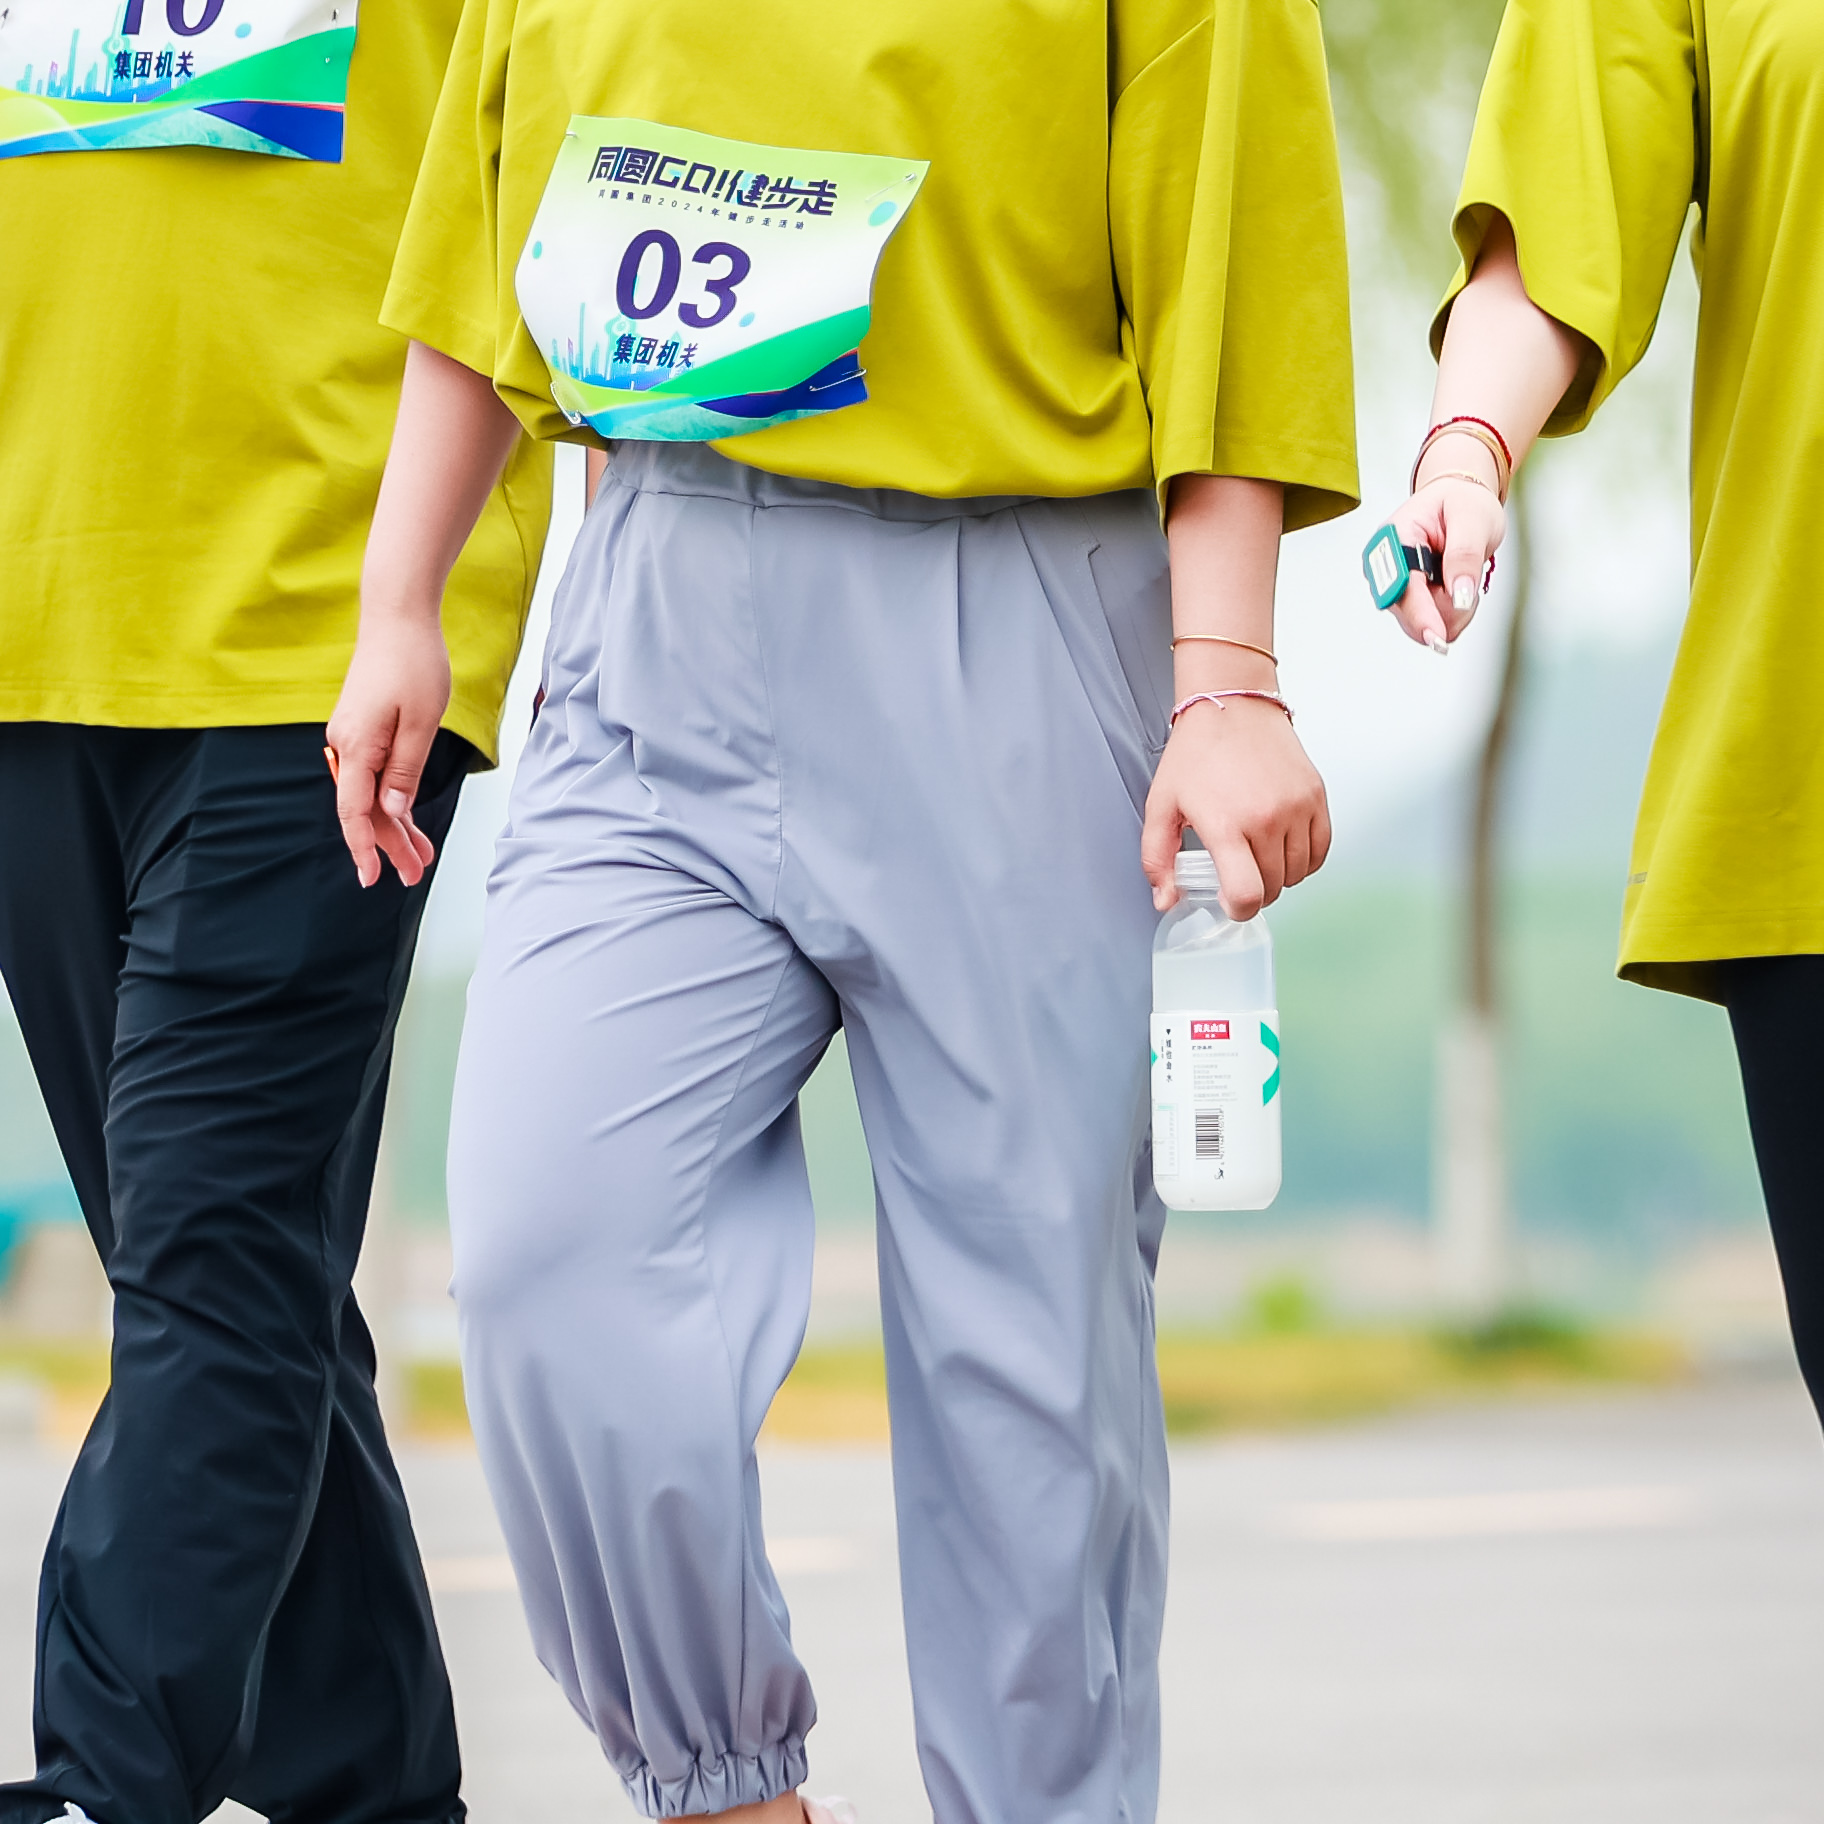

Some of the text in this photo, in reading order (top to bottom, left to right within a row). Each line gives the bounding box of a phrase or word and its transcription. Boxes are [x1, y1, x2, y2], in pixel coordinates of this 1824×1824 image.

[112, 50, 194, 80] 集团机关
[615, 229, 752, 329] 03
[612, 333, 699, 369] 集团机关
